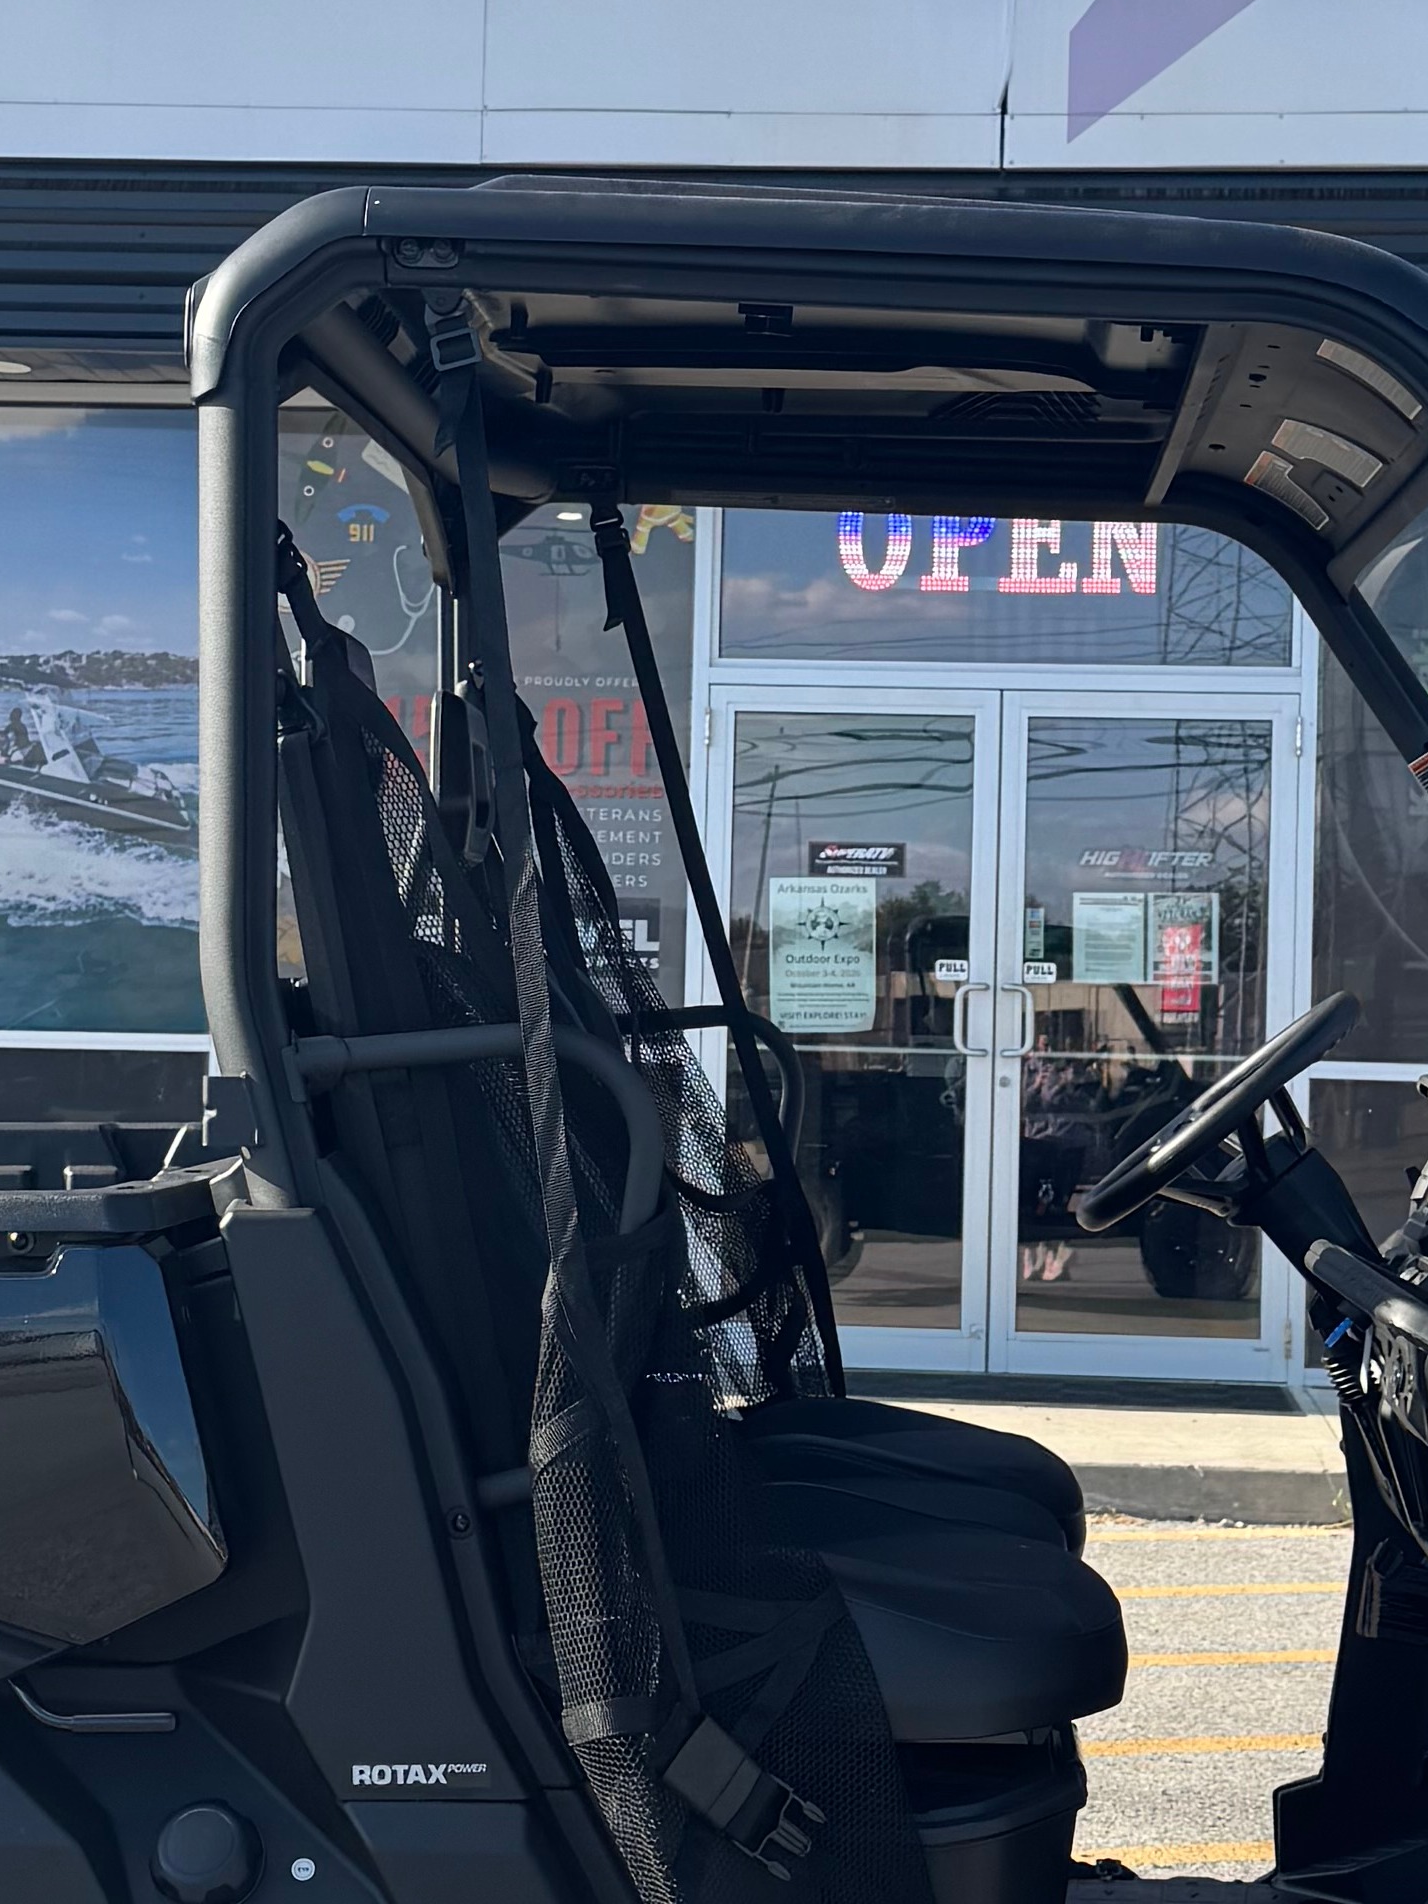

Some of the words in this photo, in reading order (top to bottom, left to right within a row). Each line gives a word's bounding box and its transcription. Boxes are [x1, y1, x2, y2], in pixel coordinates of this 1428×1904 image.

[349, 524, 375, 543] 911
[838, 511, 1158, 594] OPEN
[524, 676, 590, 687] PROUDLY
[595, 677, 642, 688] OFFER
[578, 807, 662, 822] TERANS
[777, 883, 828, 894] Arkansas
[830, 884, 868, 894] Ozarks
[785, 954, 831, 964] Outdoor
[834, 954, 861, 966] Expo
[939, 962, 966, 972] PULL
[1026, 964, 1054, 975] PULL
[352, 1763, 448, 1786] ROTAX
[447, 1763, 488, 1774] POWER
